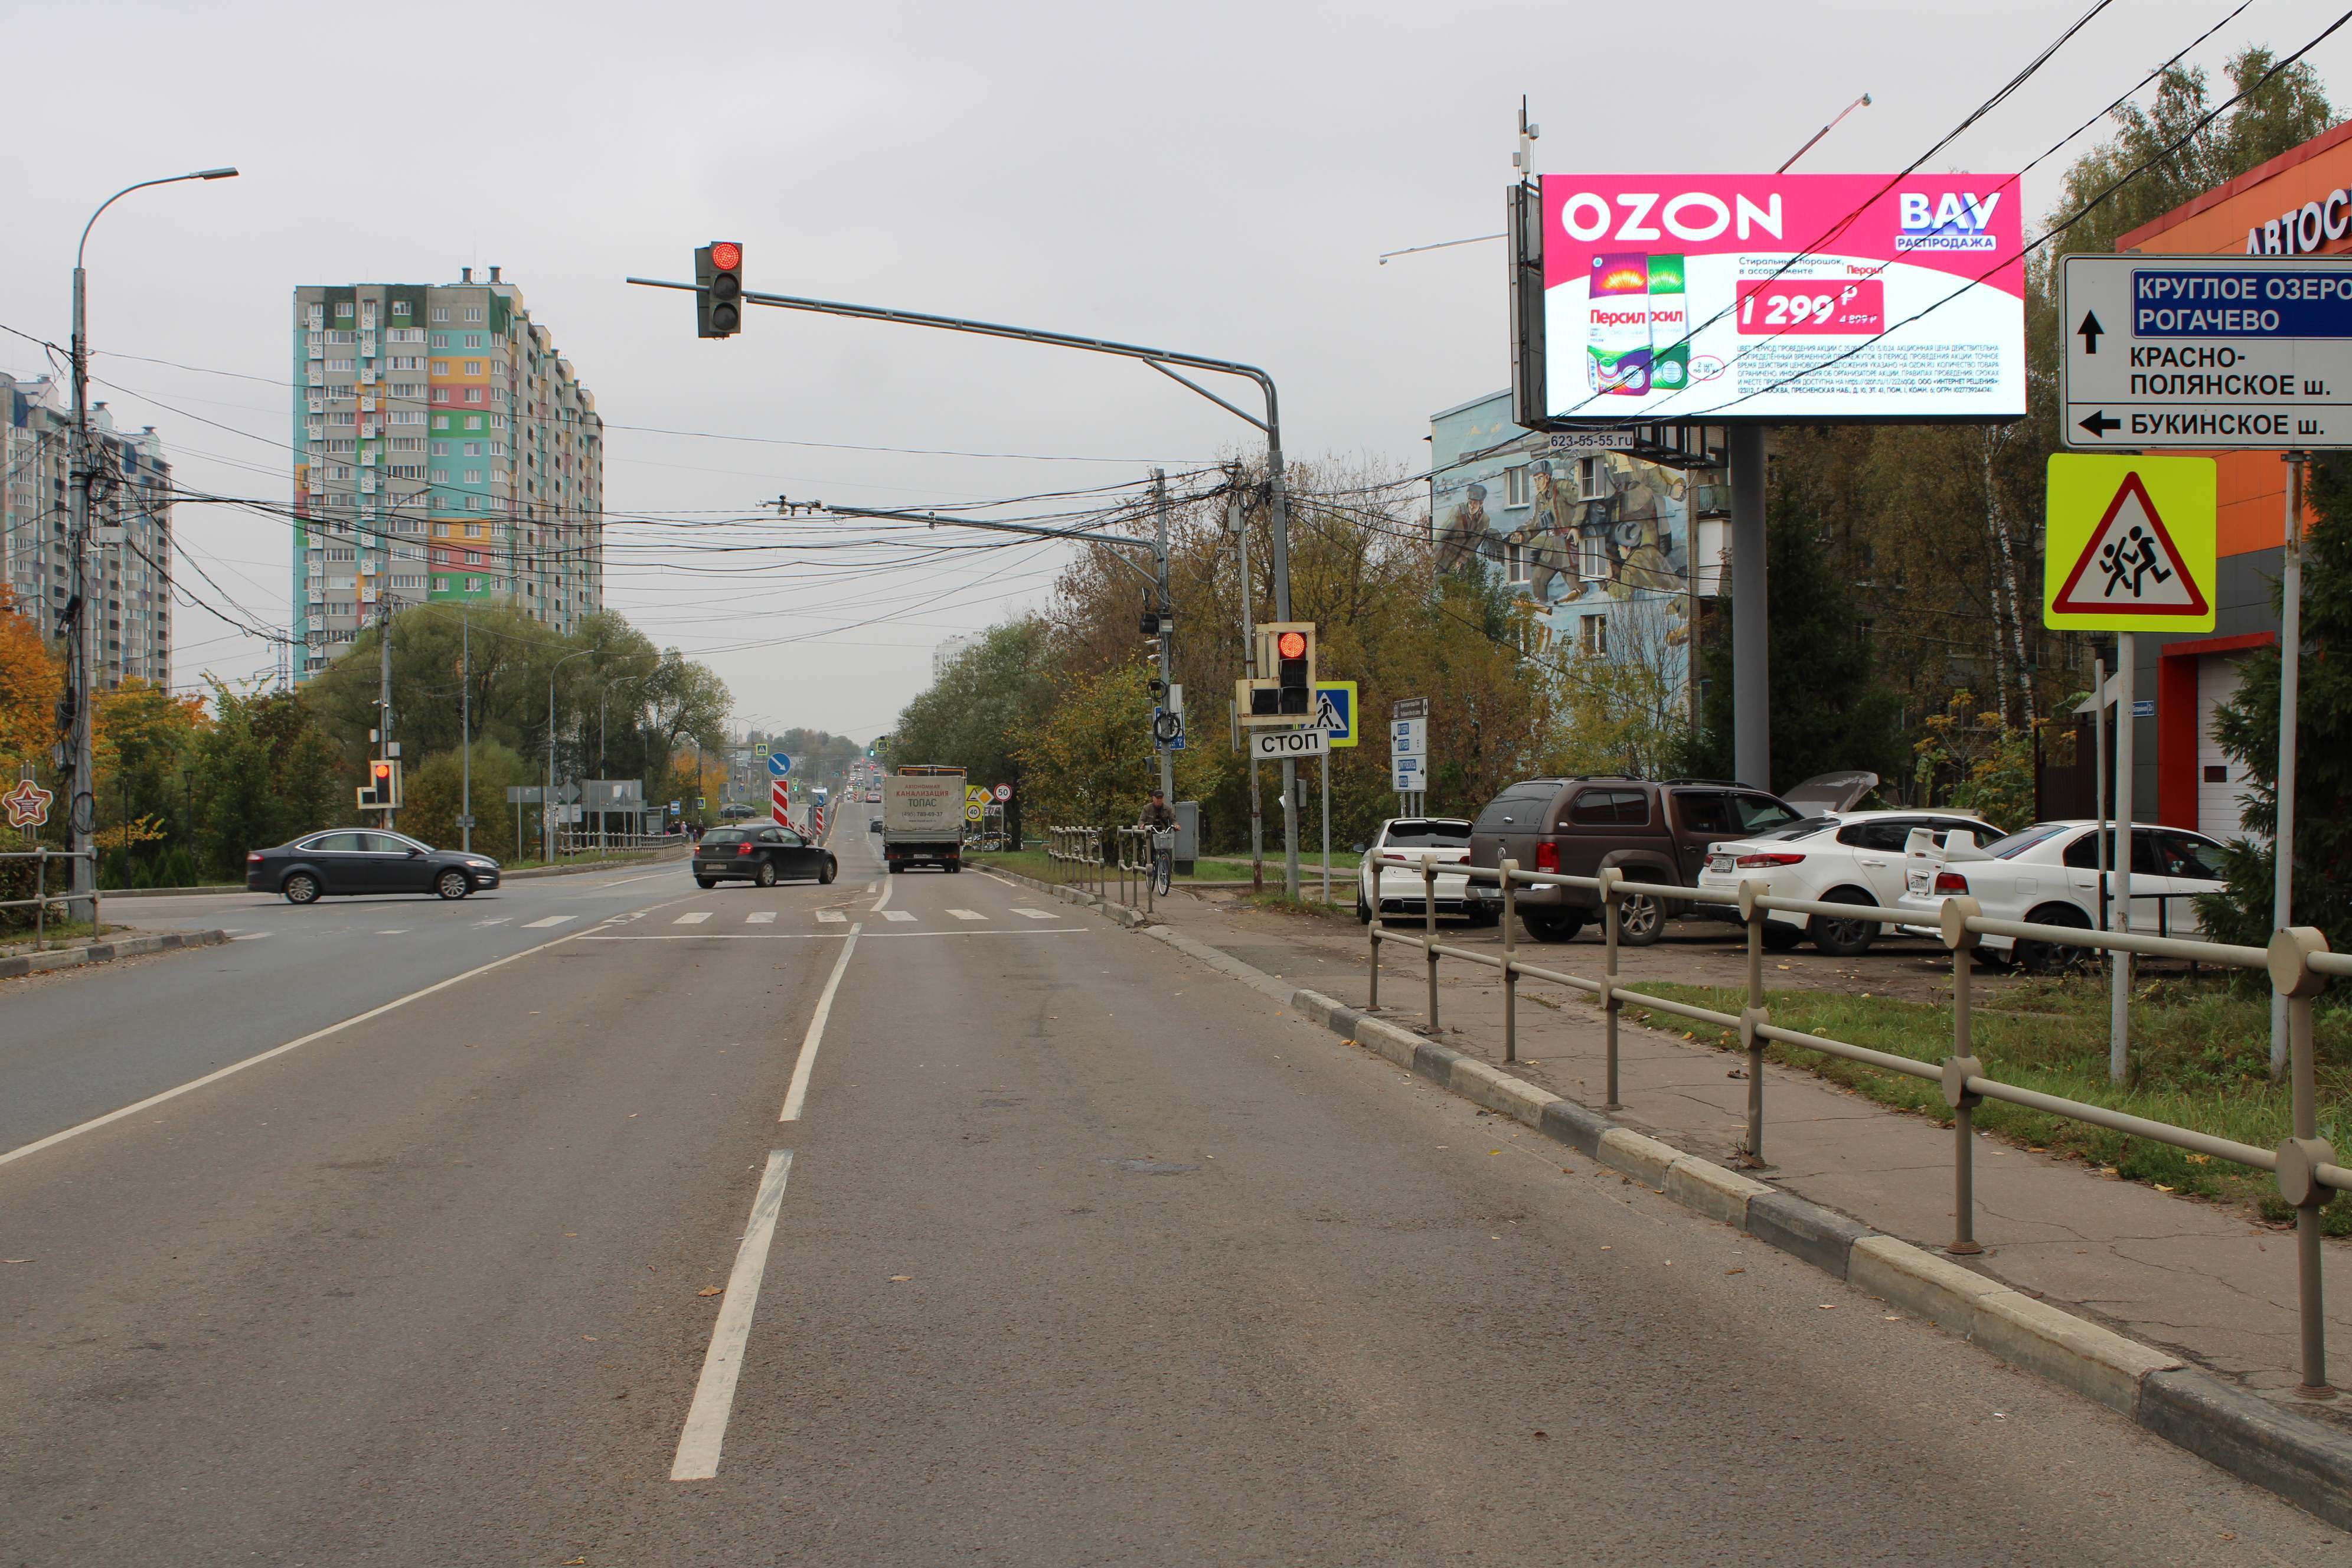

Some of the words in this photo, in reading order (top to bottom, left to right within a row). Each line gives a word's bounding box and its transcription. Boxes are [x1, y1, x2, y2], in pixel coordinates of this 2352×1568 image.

[1562, 192, 1783, 241] OZON
[1900, 192, 2002, 229] ВАУ
[1897, 237, 1994, 249] РАСПРОДАЖА
[1799, 258, 1845, 266] порошок,
[1847, 264, 1883, 276] Персил
[2138, 277, 2258, 300] КРУГЛОЕ
[2266, 278, 2352, 300] ОЗЕРО
[1590, 309, 1646, 327] Персил
[2139, 309, 2280, 331] РОГАЧЕВО
[1758, 361, 1788, 369] ДЕЙСТВИЯ
[2130, 347, 2246, 368] КРАСНО-
[2130, 374, 2295, 396] ПОЛЯНСКОЕ
[2304, 380, 2331, 396] ш.
[2131, 413, 2289, 436] БУКИНСКОЕ
[2298, 419, 2325, 436] ш.
[1551, 435, 1633, 447] 623-55-55.ru
[1261, 733, 1319, 753] СТОП
[907, 799, 937, 807] ТОПАС
